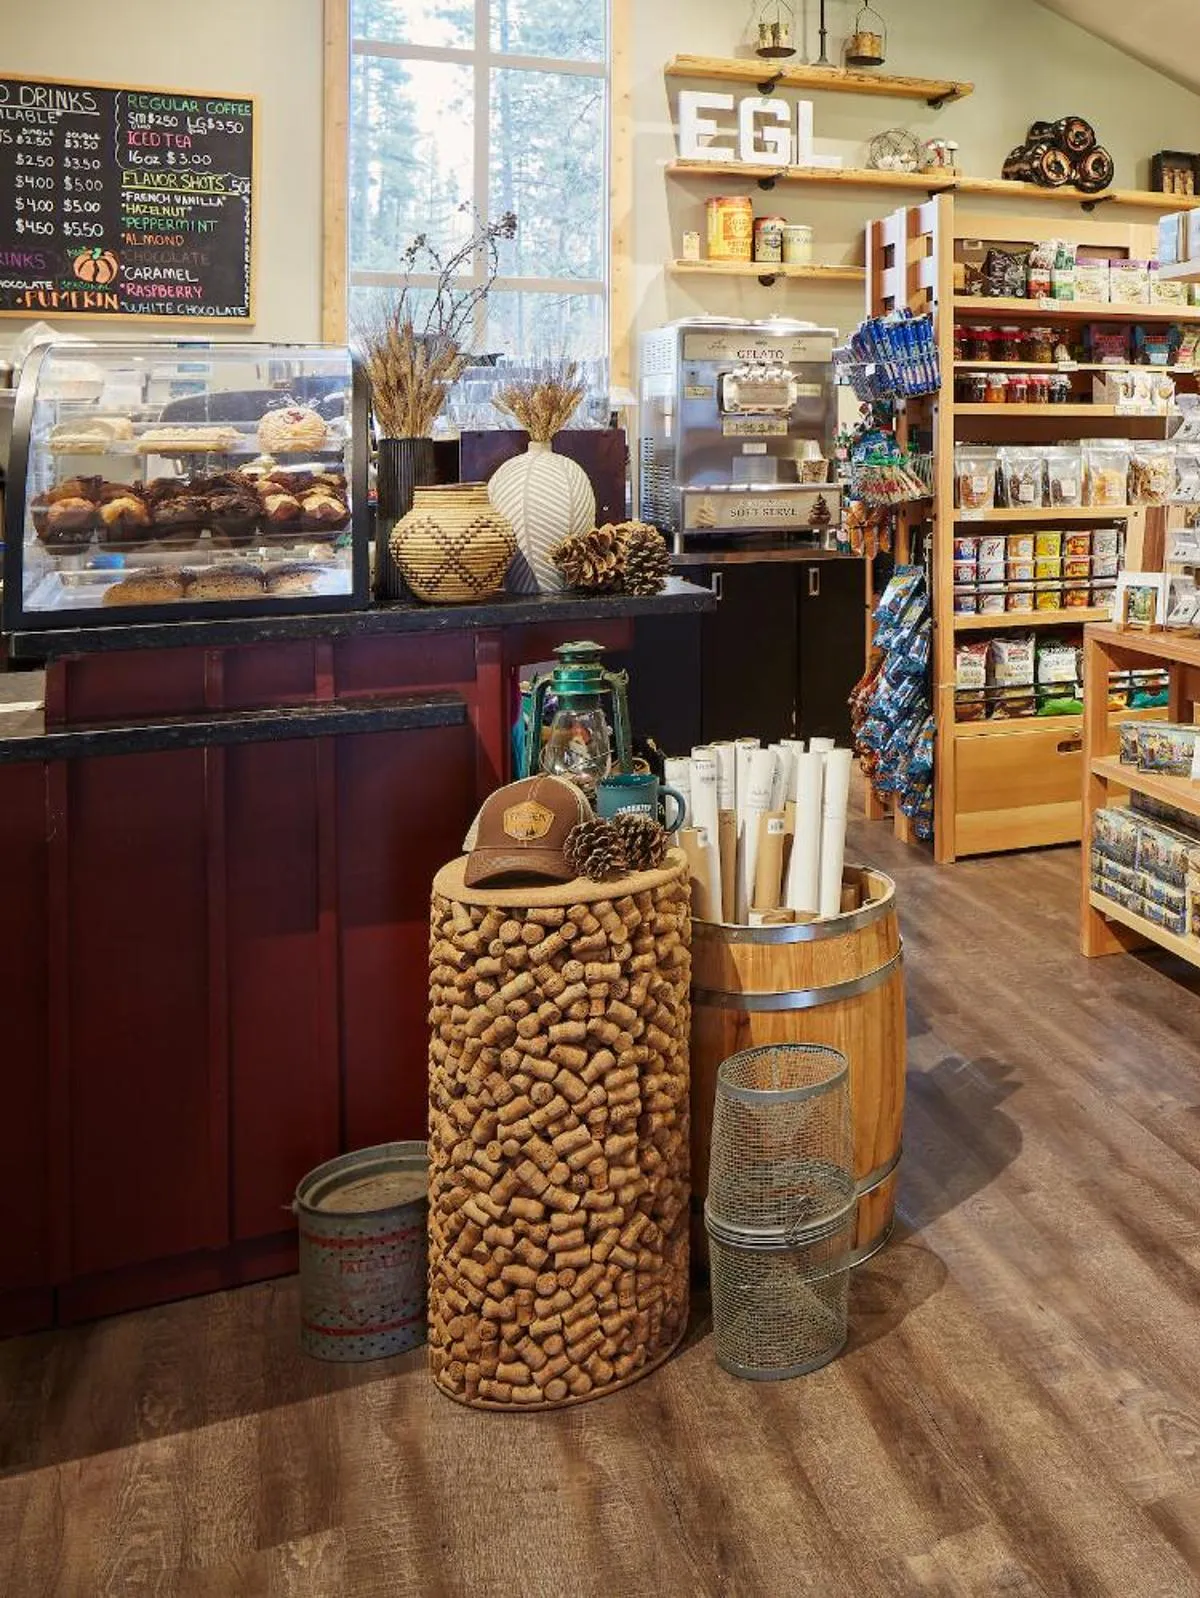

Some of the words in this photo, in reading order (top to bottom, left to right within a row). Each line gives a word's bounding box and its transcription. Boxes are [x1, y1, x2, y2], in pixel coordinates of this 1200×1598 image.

[20, 86, 97, 112] DRINKS
[127, 95, 199, 112] REGULAR
[205, 101, 251, 116] COFFEE
[679, 90, 843, 168] EGL
[127, 131, 161, 147] ICED
[163, 133, 192, 148] TEA
[16, 153, 54, 167] $2.50
[63, 156, 101, 170] $3.50
[15, 174, 54, 189] $4.00
[63, 175, 103, 192] $5.00
[122, 171, 178, 187] FLAVOR
[181, 174, 225, 191] SHOTS
[16, 197, 54, 212] $4.00
[63, 198, 101, 213] $5.00
[126, 192, 170, 204] FRENCH
[174, 195, 224, 207] VANILLA
[126, 203, 187, 217] HAZELNUT
[16, 218, 54, 235] $4.50
[63, 221, 104, 237] $5.50
[125, 218, 218, 232] PEPPERMINT
[125, 233, 185, 246] ALMOND
[124, 266, 200, 282] CARAMEL
[125, 282, 203, 299] RASPBERRY
[122, 301, 174, 314] WHITE
[177, 303, 247, 317] CHOCOLATE
[737, 350, 785, 360] GELATO
[730, 507, 759, 518] SOFT
[762, 507, 798, 518] SERVE
